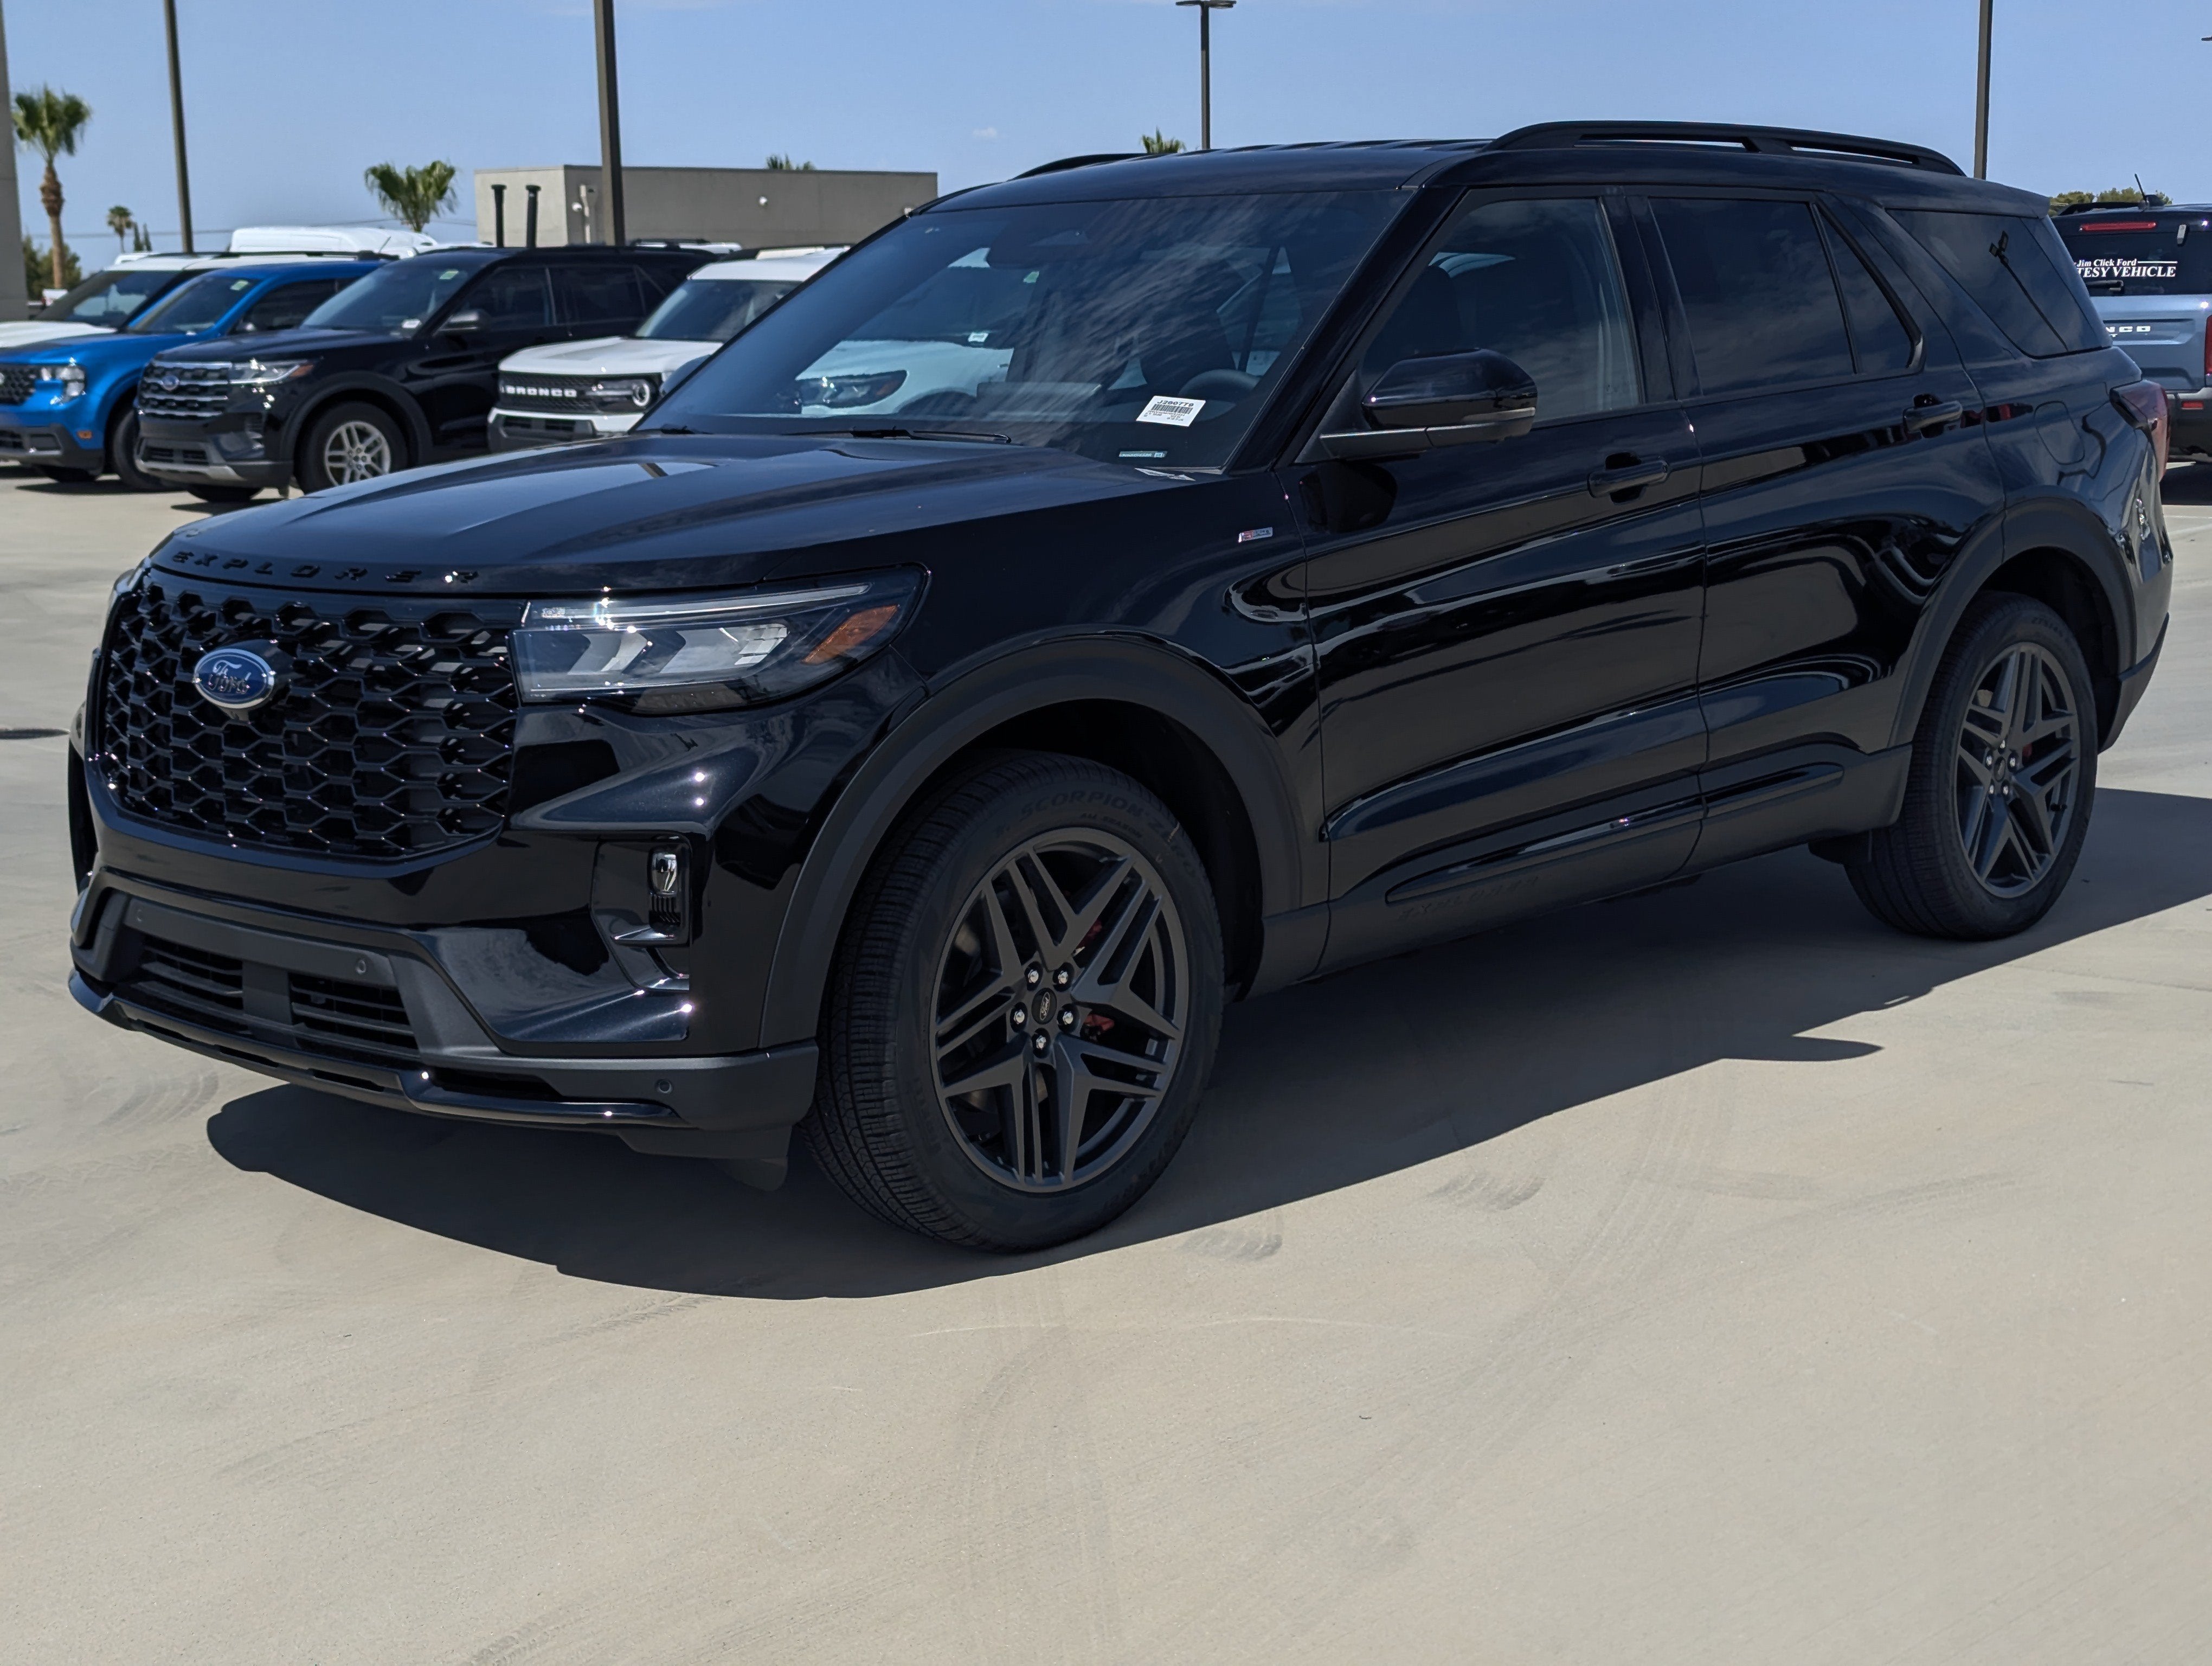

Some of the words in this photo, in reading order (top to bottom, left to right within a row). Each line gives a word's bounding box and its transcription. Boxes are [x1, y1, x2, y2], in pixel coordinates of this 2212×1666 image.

[2113, 266, 2176, 278] VEHICLE
[2117, 258, 2137, 266] Ford
[505, 385, 577, 398] BRONCO
[172, 551, 479, 584] EXPLORER
[207, 659, 252, 694] Ford
[1019, 790, 1143, 822] SCORPION
